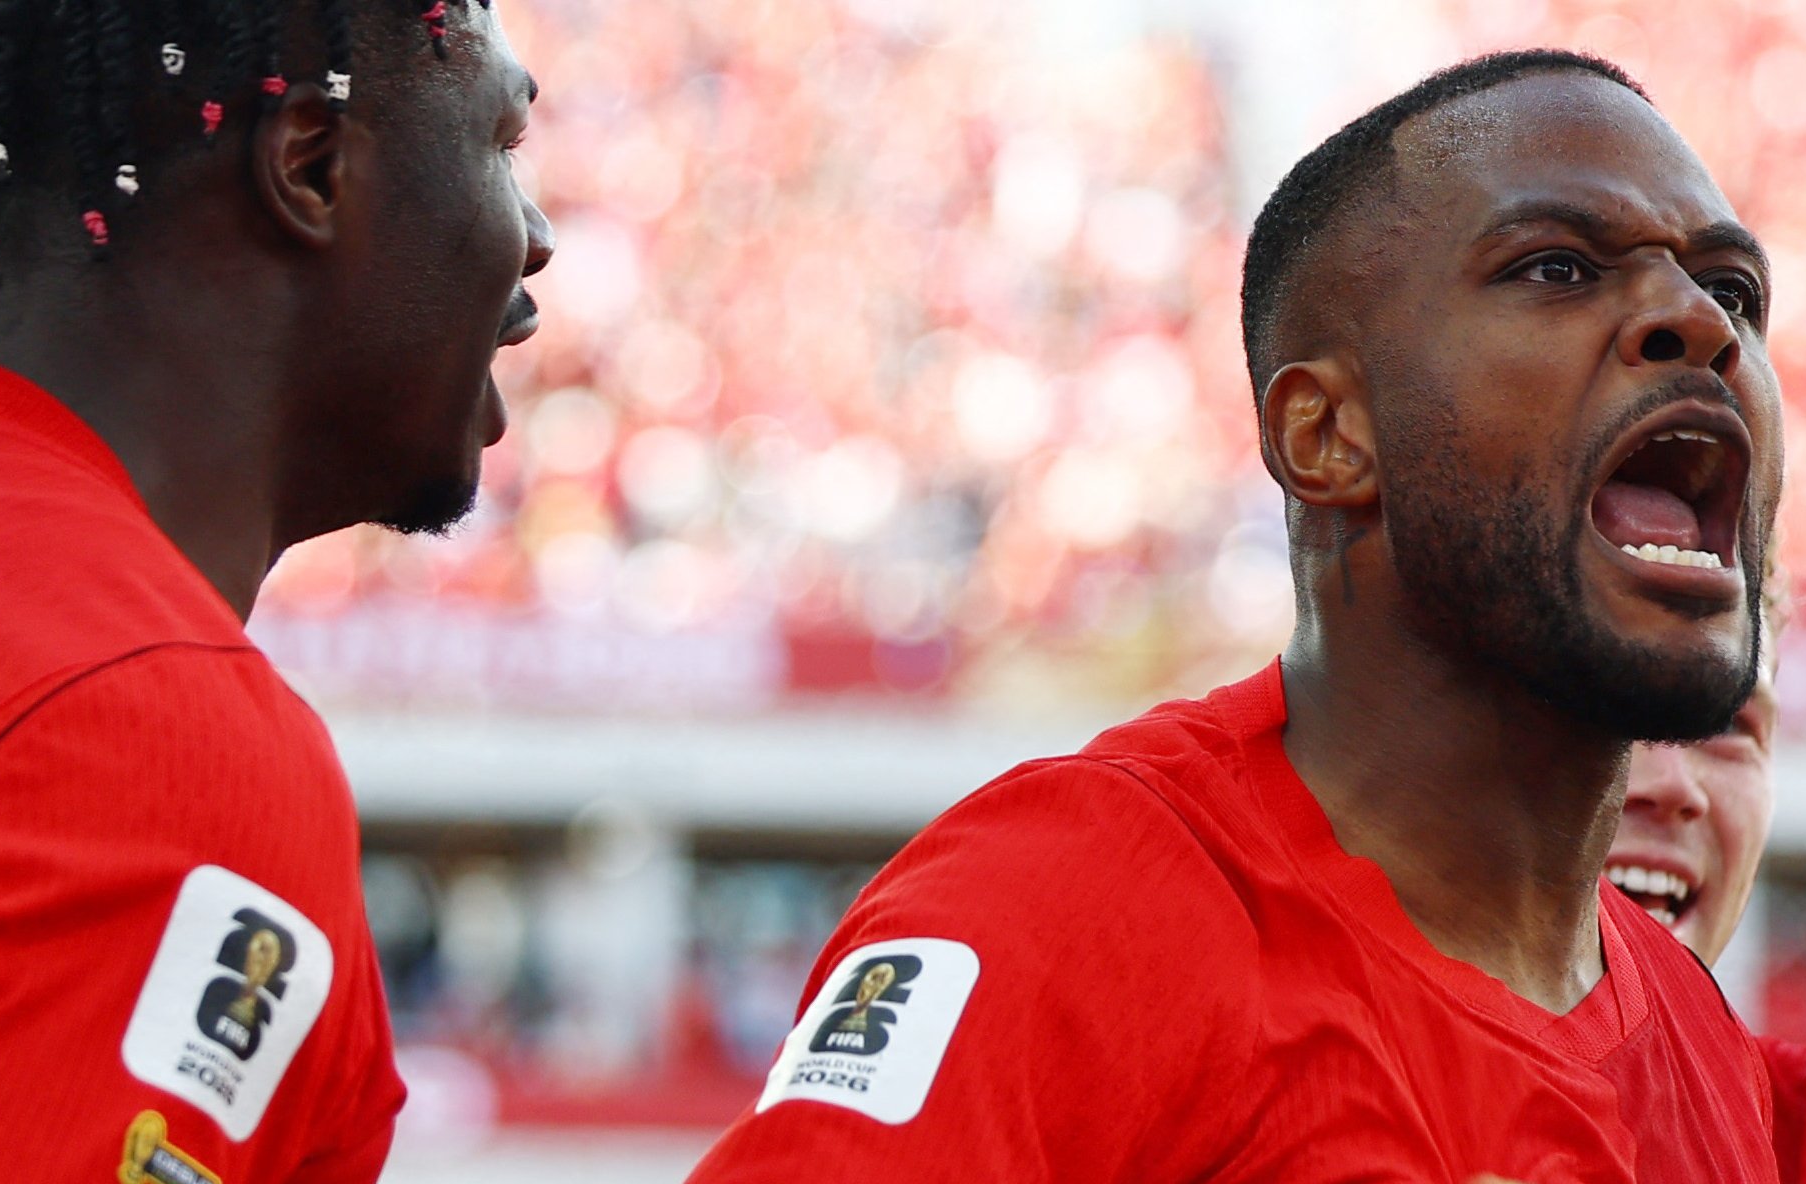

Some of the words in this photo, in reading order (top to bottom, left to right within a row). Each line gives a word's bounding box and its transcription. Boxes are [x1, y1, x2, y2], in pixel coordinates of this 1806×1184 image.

[825, 1032, 865, 1049] FIFA
[847, 1061, 877, 1075] CUP
[788, 1070, 869, 1094] 2026
